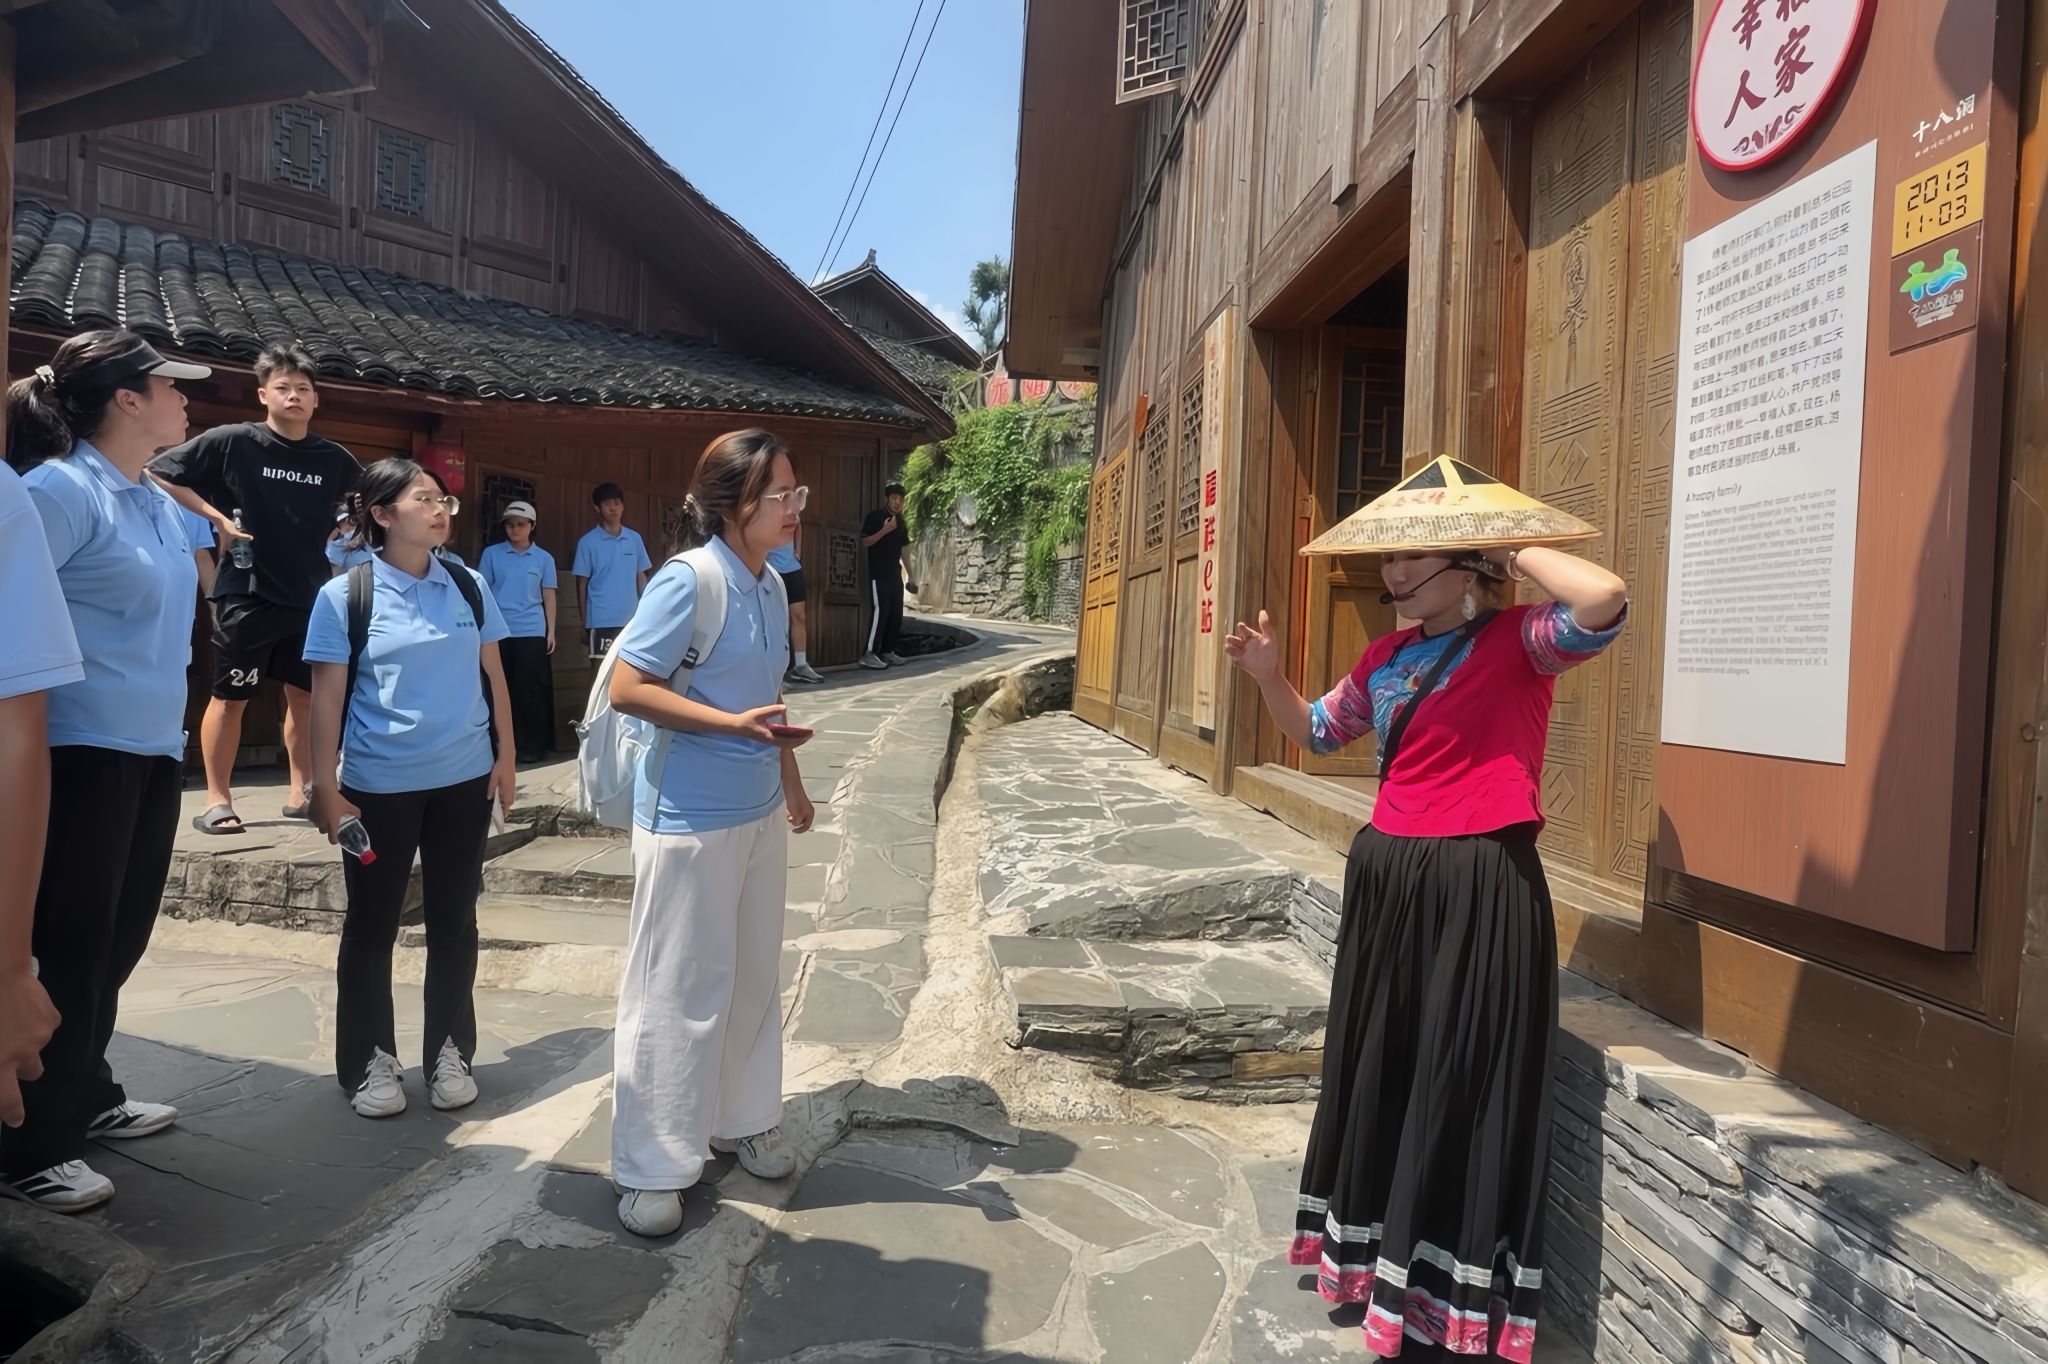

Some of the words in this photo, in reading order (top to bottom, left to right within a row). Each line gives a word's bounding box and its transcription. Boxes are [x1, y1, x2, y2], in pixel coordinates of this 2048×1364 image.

[1912, 94, 1975, 143] 十八洞
[1907, 160, 1970, 212] 2013
[263, 467, 323, 486] BIPOLAR
[230, 668, 259, 687] 24
